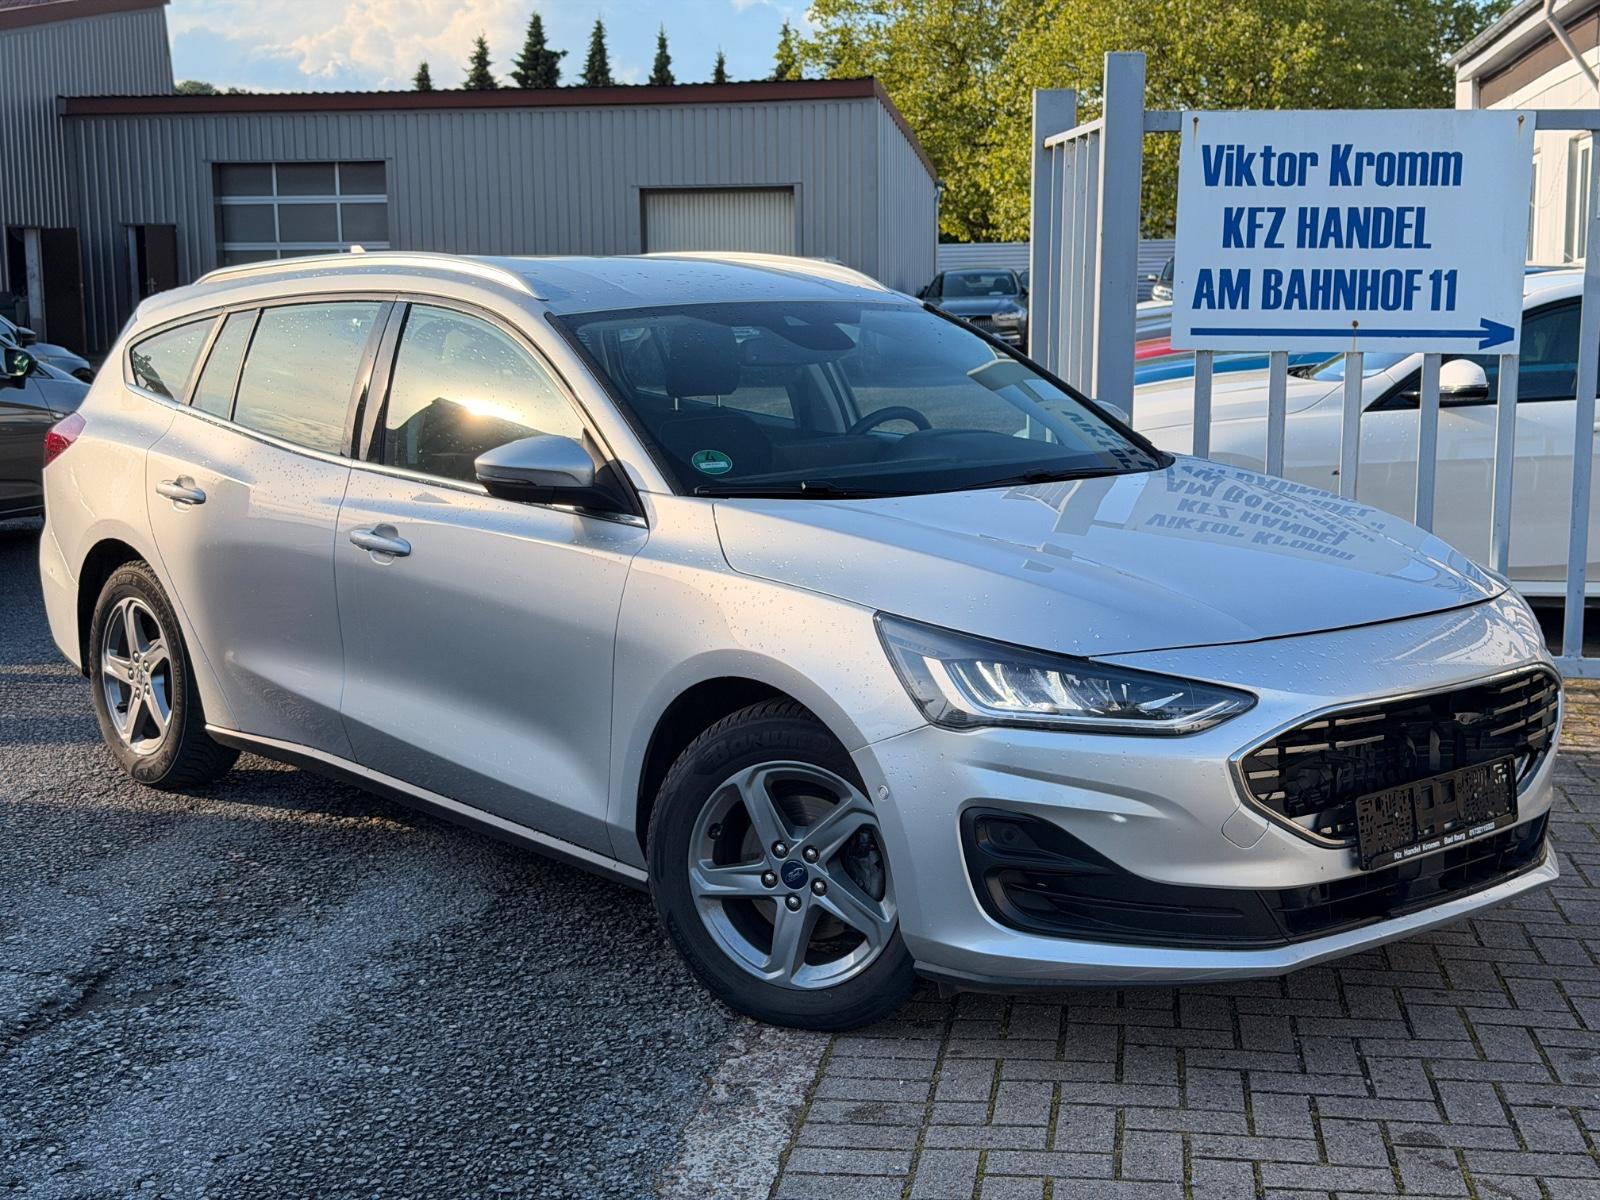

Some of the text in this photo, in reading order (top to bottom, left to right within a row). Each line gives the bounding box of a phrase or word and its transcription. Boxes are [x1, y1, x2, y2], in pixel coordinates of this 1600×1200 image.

[1202, 144, 1463, 187] Viktor Kromm
[1222, 206, 1432, 249] KFZ HANDEL
[1191, 268, 1458, 311] AM BAHNHOF 11
[1403, 845, 1421, 857] Handel
[1422, 841, 1440, 852] Kromm
[1443, 835, 1454, 845] Bad
